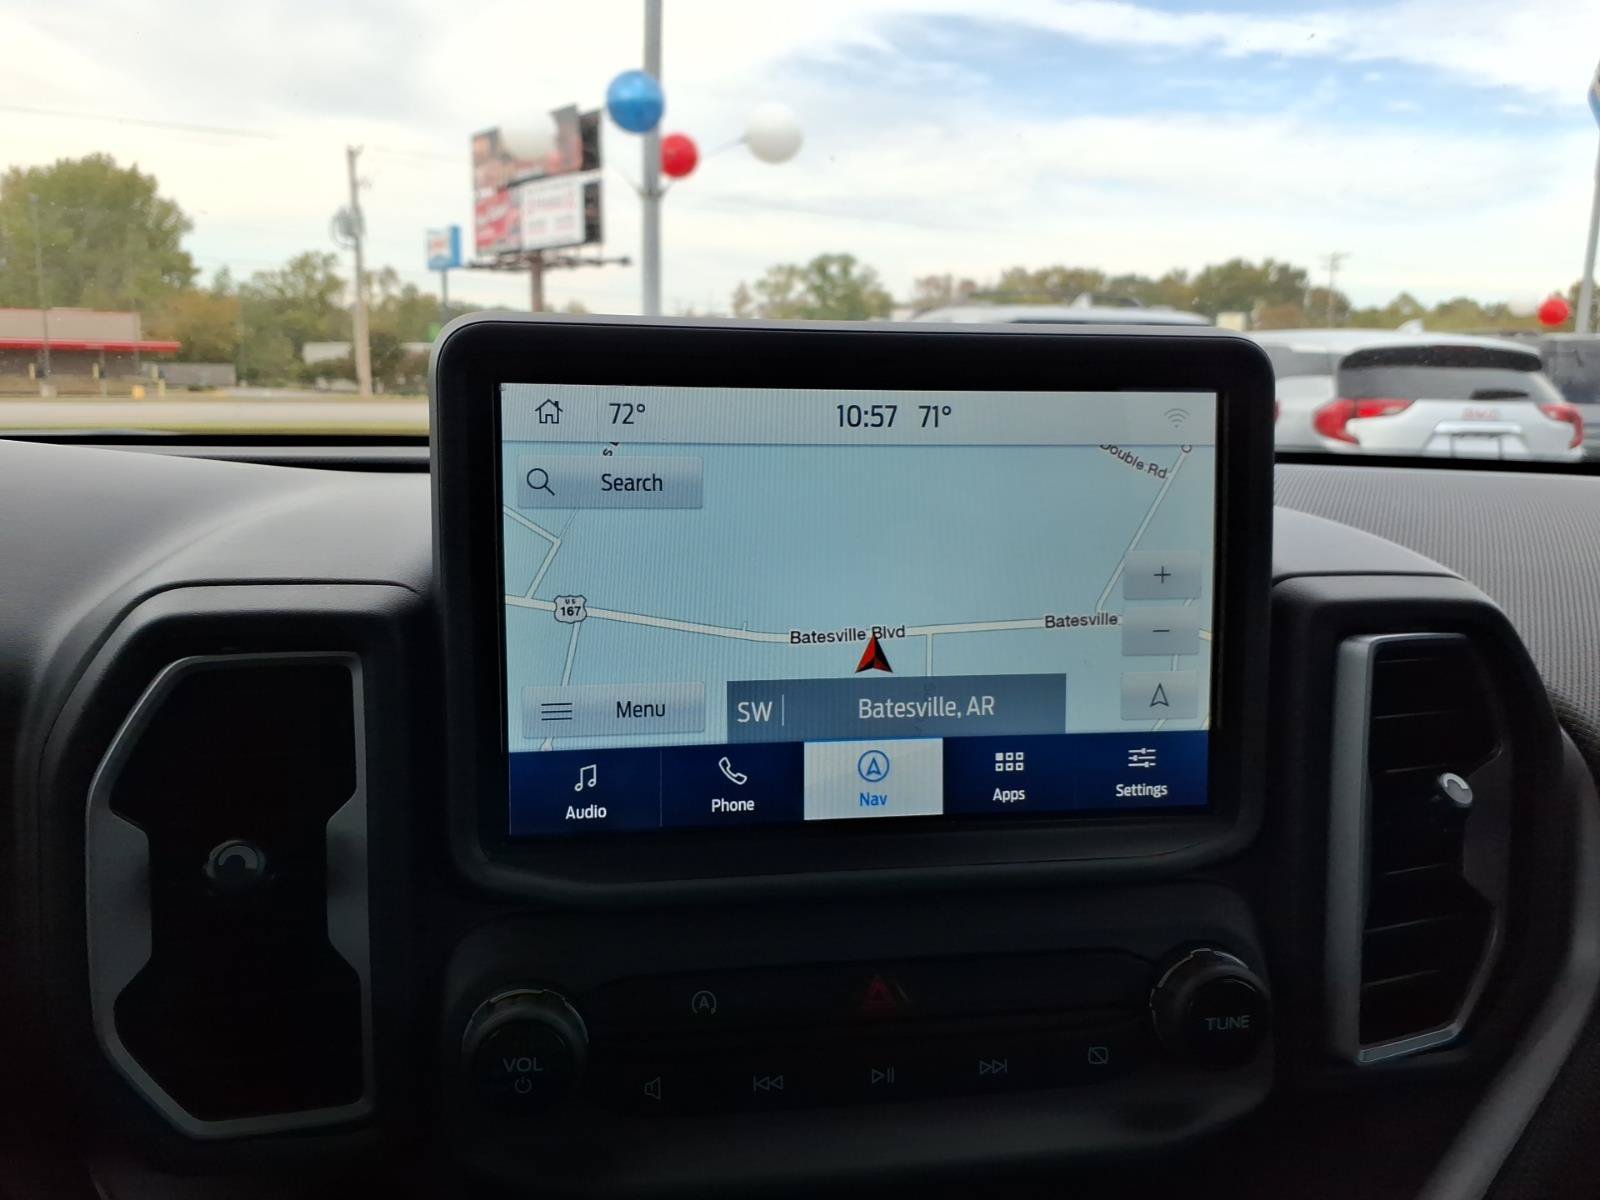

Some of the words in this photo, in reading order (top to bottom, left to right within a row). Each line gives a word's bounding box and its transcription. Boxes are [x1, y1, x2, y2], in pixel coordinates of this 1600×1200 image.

[608, 402, 646, 425] 72°
[836, 404, 898, 428] 10:57
[918, 405, 952, 428] 71°
[1147, 462, 1168, 479] Rd
[601, 473, 663, 492] Search
[560, 605, 582, 617] 167
[1044, 612, 1118, 629] Batesville
[790, 628, 866, 644] Batesville
[871, 625, 906, 640] Blvd
[616, 700, 666, 719] Menu
[737, 701, 773, 723] SW
[858, 697, 962, 719] Batesville,
[966, 695, 995, 716] AR
[859, 791, 888, 807] Nav
[992, 787, 1026, 804] Apps
[1115, 783, 1168, 799] Settings
[565, 803, 607, 820] Audio
[711, 797, 755, 813] Phone
[1205, 1014, 1250, 1031] TUNE
[503, 1056, 543, 1073] VOL
